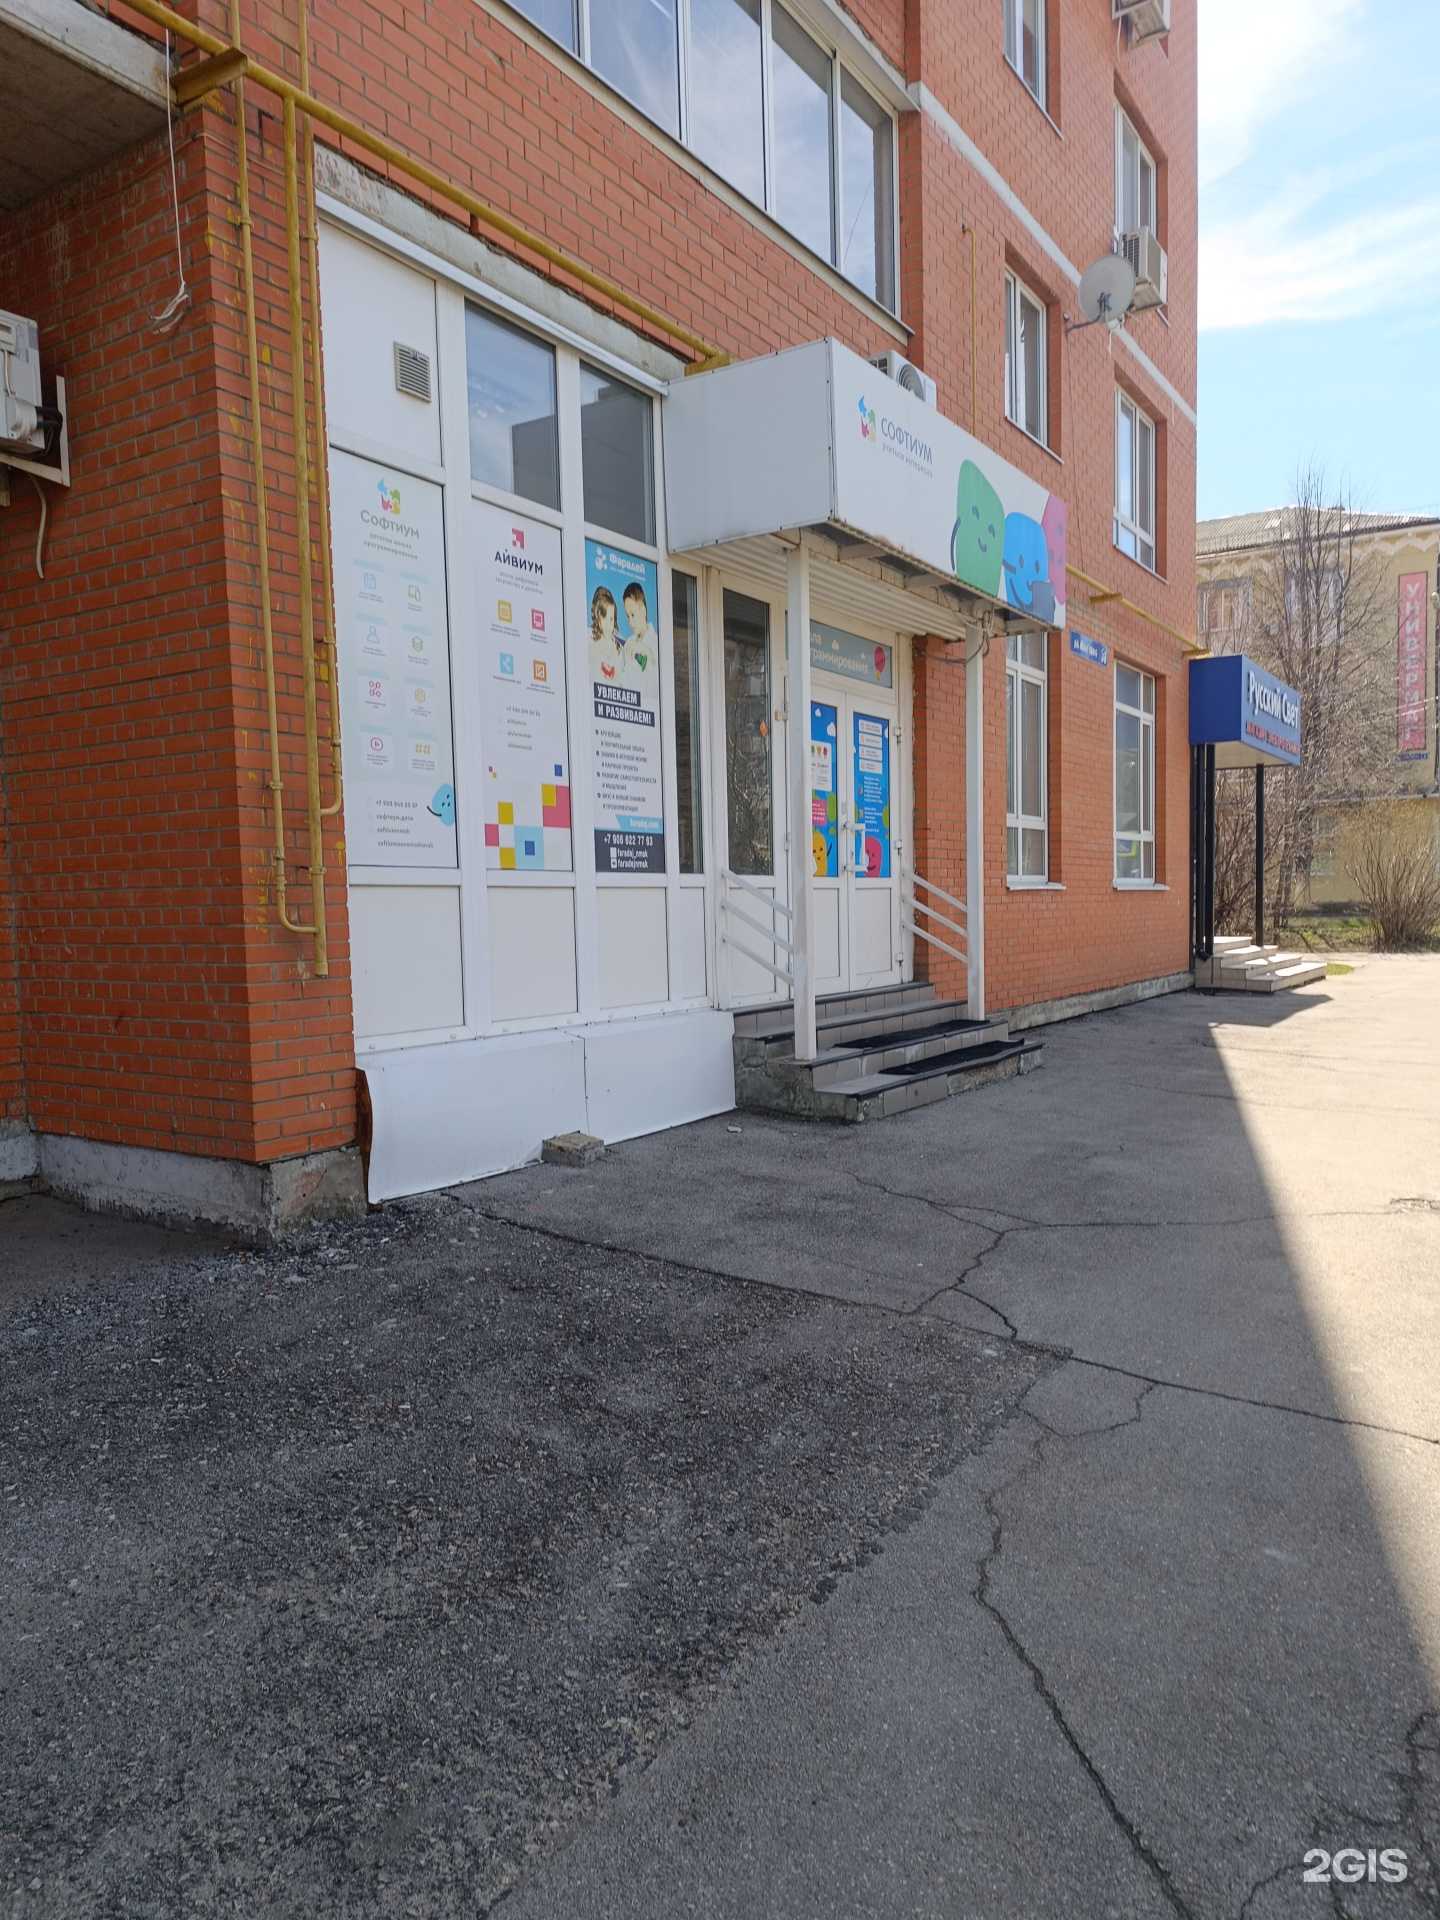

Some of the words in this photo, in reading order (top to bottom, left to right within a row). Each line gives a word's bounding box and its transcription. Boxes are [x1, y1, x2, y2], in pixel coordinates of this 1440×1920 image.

[881, 417, 933, 465] СОФТИУМ
[360, 509, 420, 540] Софтиум
[494, 548, 544, 577] АЙВИУМ
[597, 685, 638, 705] УВЛЕКАЕМ
[1248, 669, 1281, 720] Русский
[1281, 692, 1300, 729] Свет
[598, 703, 604, 717] И
[605, 705, 652, 725] РАЗВИВАЕМ!
